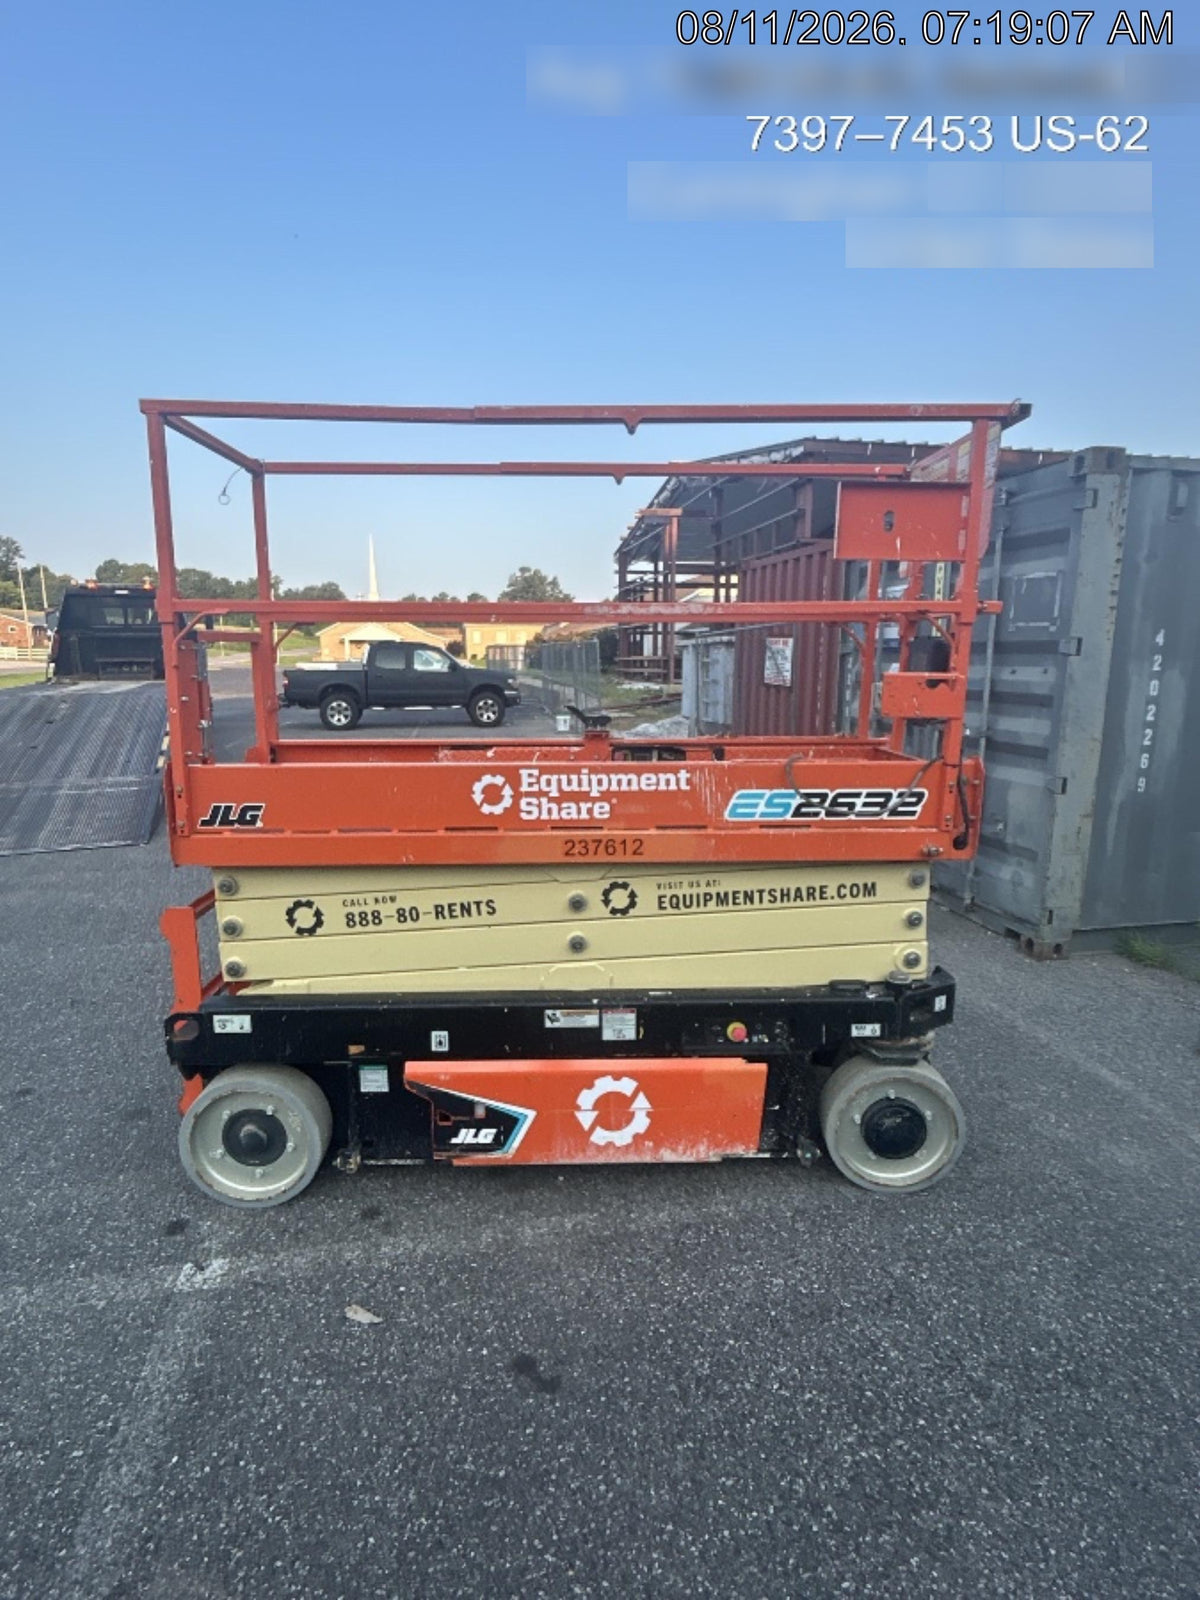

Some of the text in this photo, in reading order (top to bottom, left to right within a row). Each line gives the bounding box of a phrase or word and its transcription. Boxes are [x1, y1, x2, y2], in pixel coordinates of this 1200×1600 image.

[518, 768, 691, 797] Equipment
[197, 803, 265, 829] JLG
[518, 797, 611, 821] Share
[725, 788, 928, 821] ES2632
[563, 838, 644, 857] 237612
[656, 880, 684, 891] VISIT
[688, 880, 701, 890] US
[656, 881, 877, 911] EQUIPMENTSHARE.COM
[342, 895, 398, 908] CALL NOW
[345, 899, 497, 929] 888-80-RENTS
[449, 1128, 498, 1144] JLG
